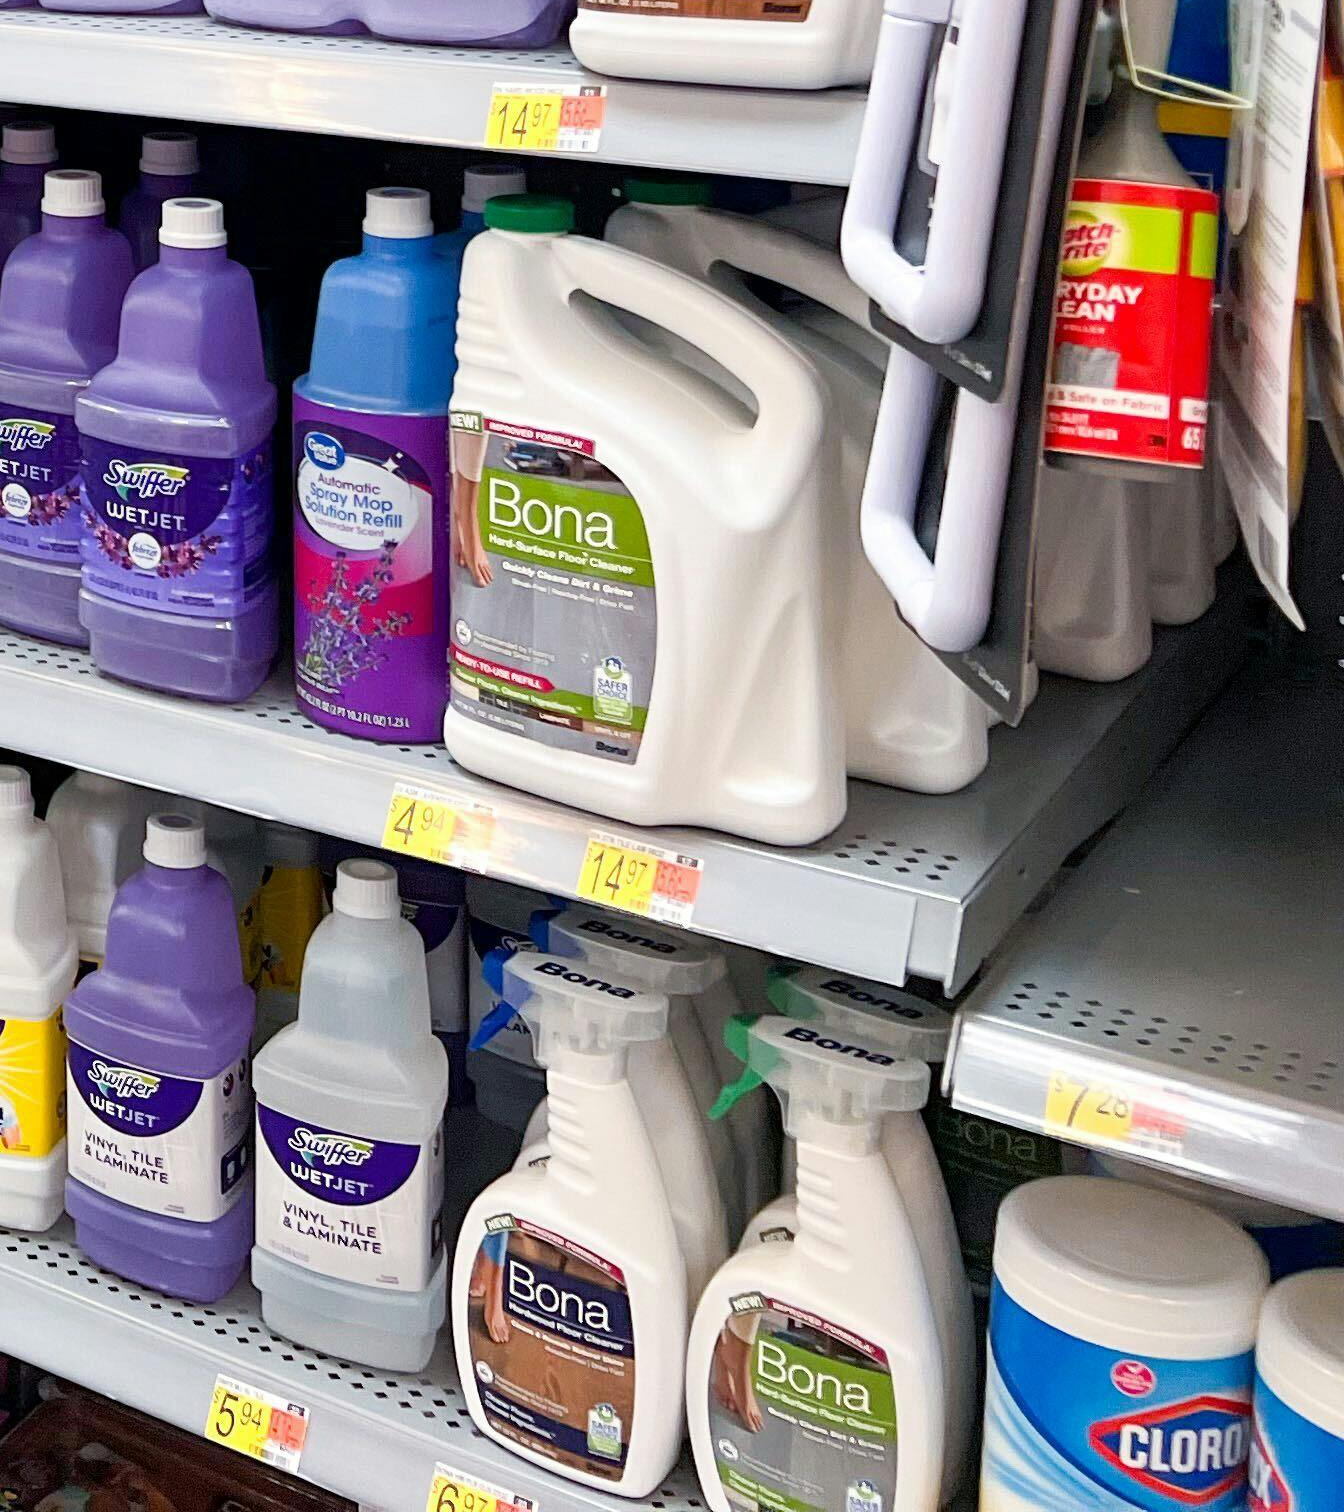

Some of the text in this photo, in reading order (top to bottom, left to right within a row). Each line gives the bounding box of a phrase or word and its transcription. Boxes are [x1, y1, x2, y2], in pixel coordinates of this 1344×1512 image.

[307, 437, 339, 457] Great
[309, 485, 394, 511] Spray Mop
[318, 470, 381, 494] Automatic
[105, 501, 185, 530] WETJET
[306, 498, 403, 530] Solution Refill
[489, 480, 615, 552] Bona
[489, 534, 635, 575] Hard-Surface Floor Cleaner
[598, 680, 627, 691] SAFER
[578, 917, 678, 954] Bona
[783, 1026, 895, 1066] Bona
[87, 1061, 159, 1094] Swiffer
[84, 1131, 164, 1168] VINYL, TILE
[97, 1151, 168, 1184] LAMINATE
[283, 1202, 376, 1238] VINYL, TILE
[508, 1262, 610, 1333] Bona
[757, 1340, 872, 1415] Bona
